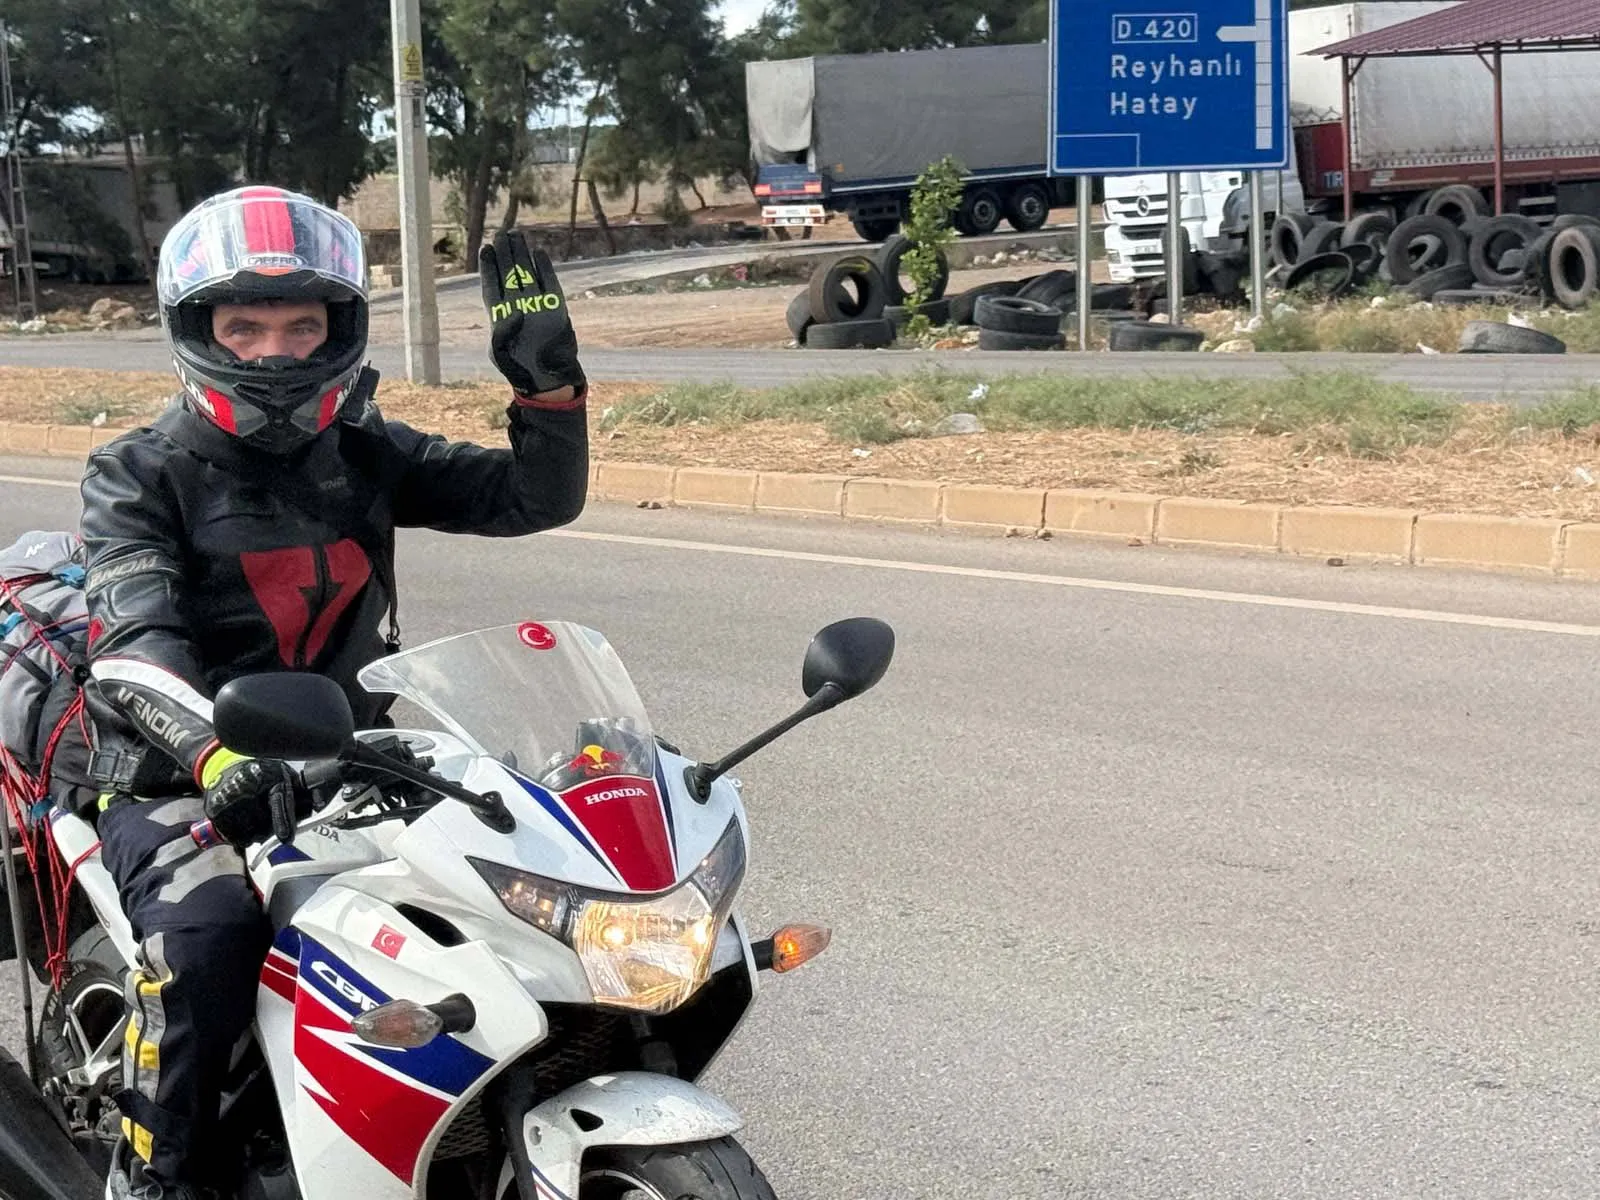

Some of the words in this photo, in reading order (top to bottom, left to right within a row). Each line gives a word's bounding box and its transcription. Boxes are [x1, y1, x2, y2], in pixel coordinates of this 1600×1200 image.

[1111, 53, 1241, 84] Reyhanlı
[1110, 91, 1198, 120] Hatay
[117, 686, 192, 749] VENOM
[584, 787, 649, 806] HONDA
